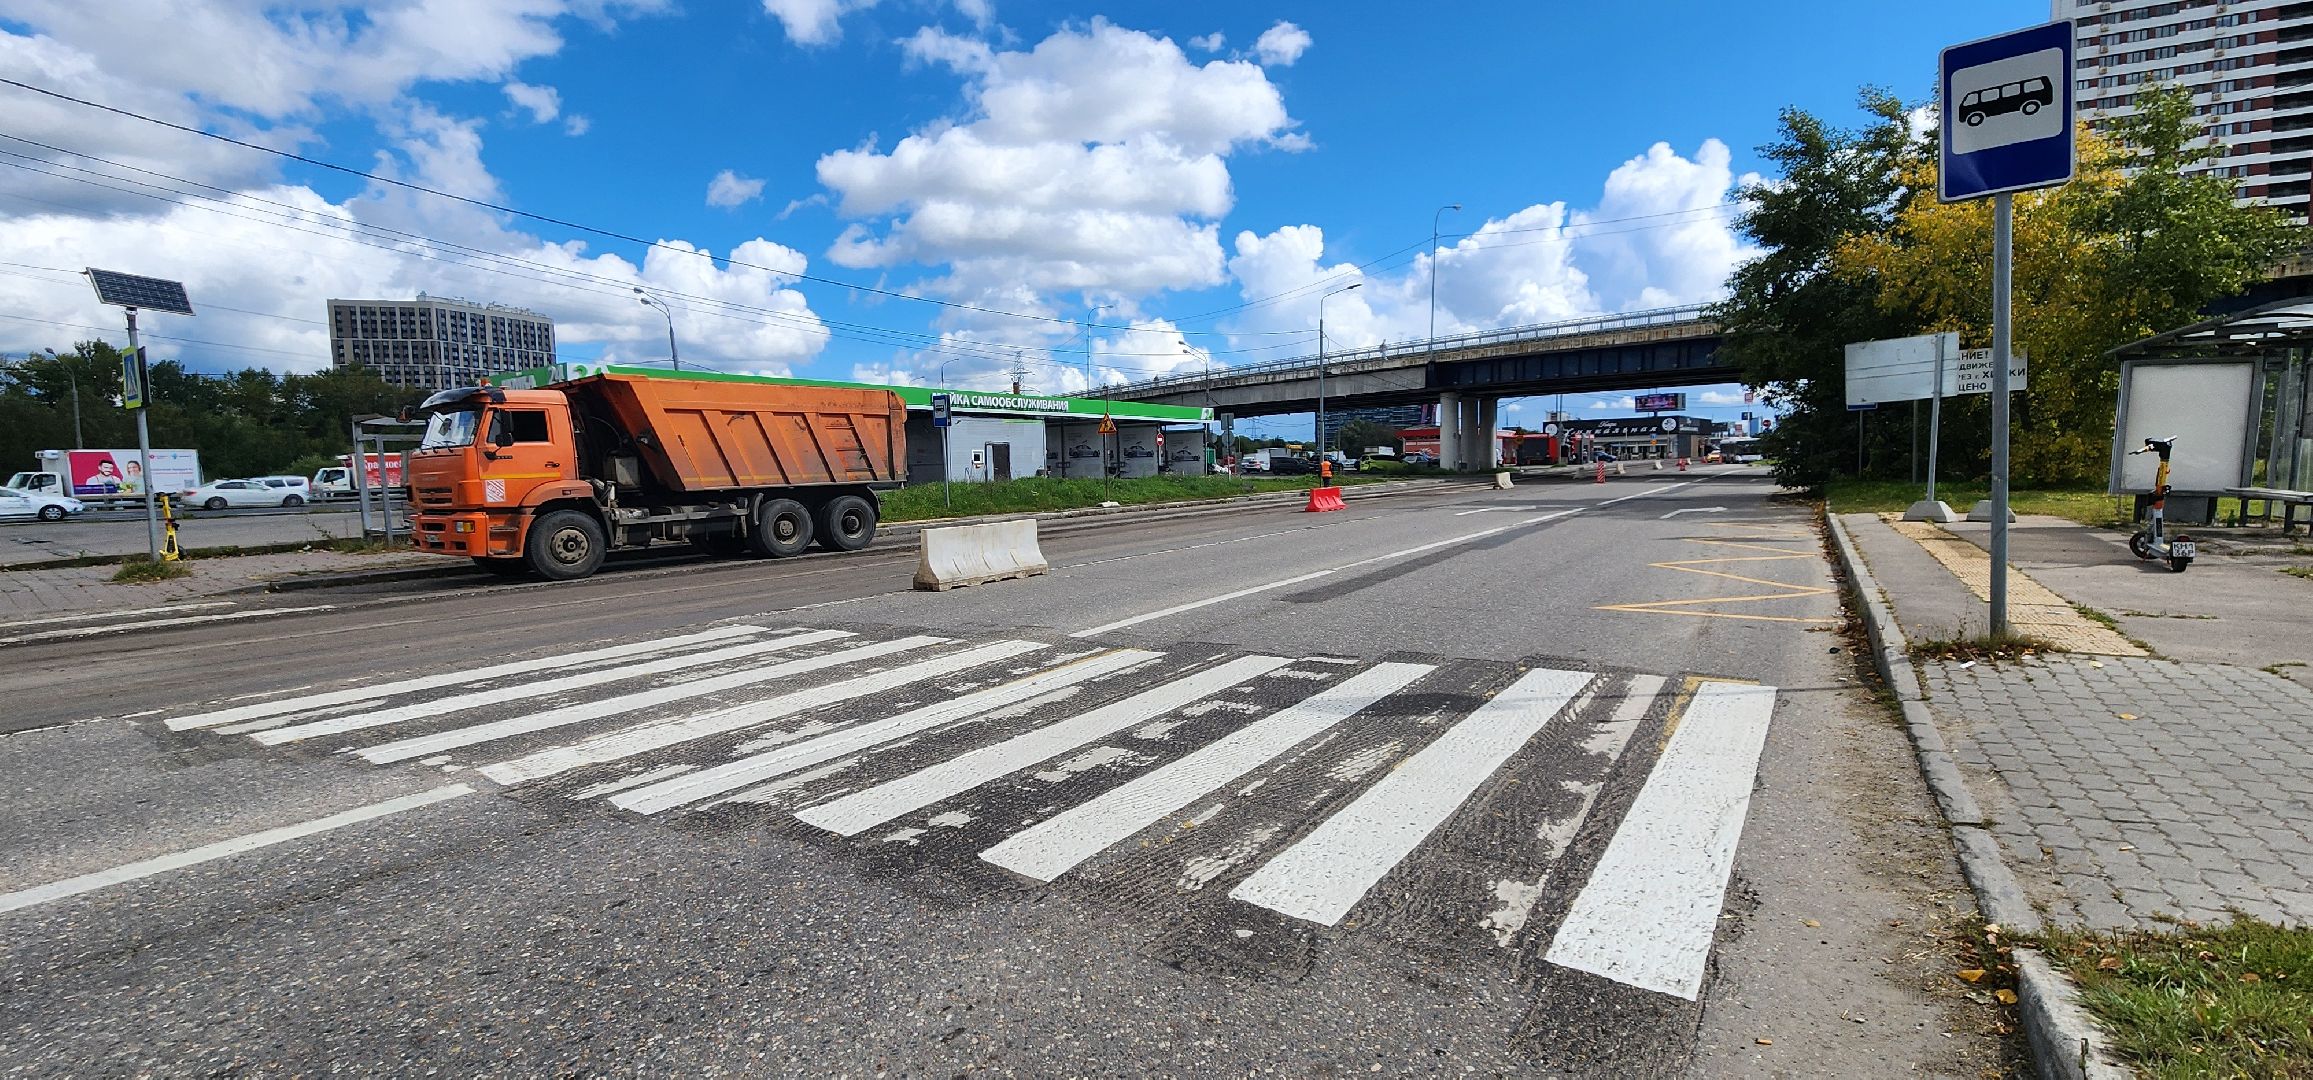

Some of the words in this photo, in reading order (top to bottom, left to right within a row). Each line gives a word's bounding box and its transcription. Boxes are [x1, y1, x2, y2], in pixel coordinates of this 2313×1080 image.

[1959, 351, 1988, 360] НИЕ!
[1959, 362, 1994, 371] ДВИЖЕ
[1982, 368, 2026, 379] ХКИ
[932, 392, 970, 406] ЙКА
[971, 395, 1069, 411] САМООБСЛУЖИВАНИЯ
